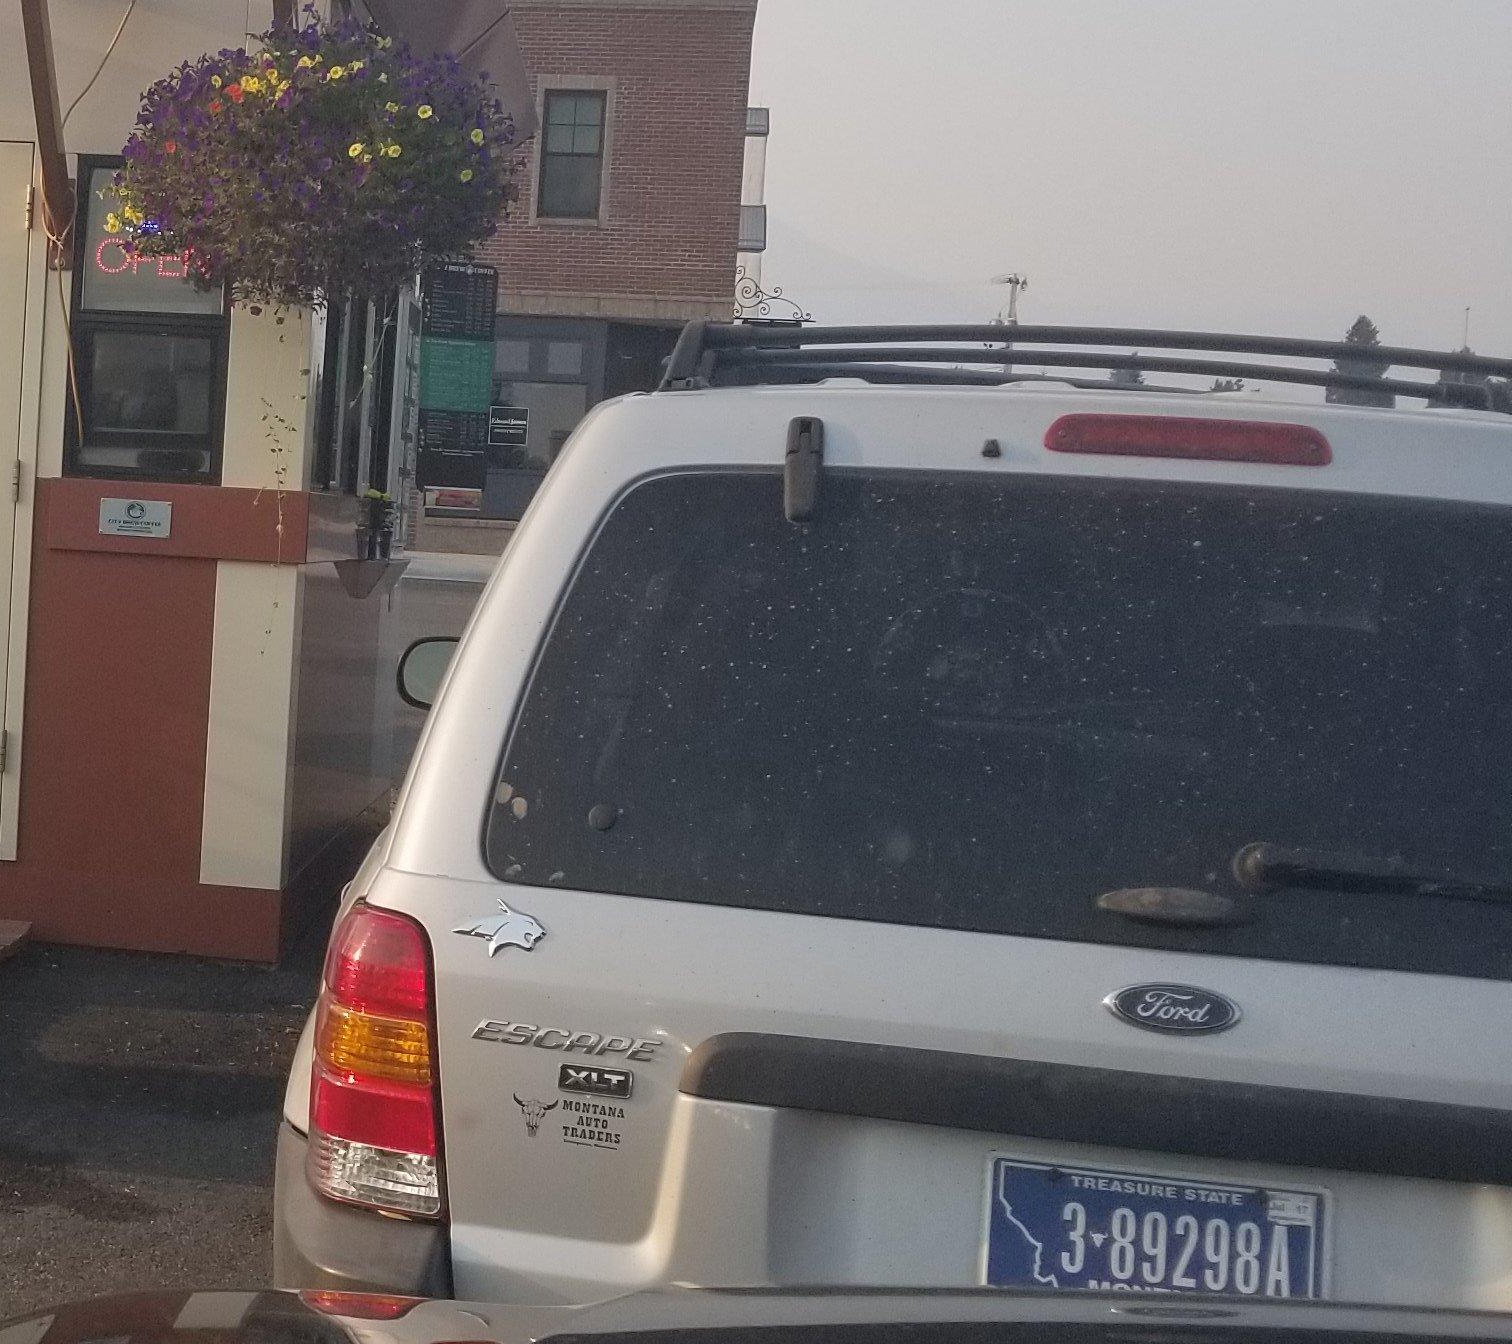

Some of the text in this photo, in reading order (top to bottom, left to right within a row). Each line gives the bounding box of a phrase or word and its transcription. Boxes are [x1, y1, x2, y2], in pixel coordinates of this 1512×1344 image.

[1137, 991, 1211, 1023] Ford
[471, 1018, 664, 1063] ESCAPE
[564, 1067, 626, 1088] XLT
[562, 1099, 626, 1119] MONTANA
[576, 1115, 609, 1130] AUTO
[562, 1125, 622, 1145] TRADERS
[1070, 1175, 1178, 1200] TREASURE
[1184, 1187, 1243, 1206] STATE
